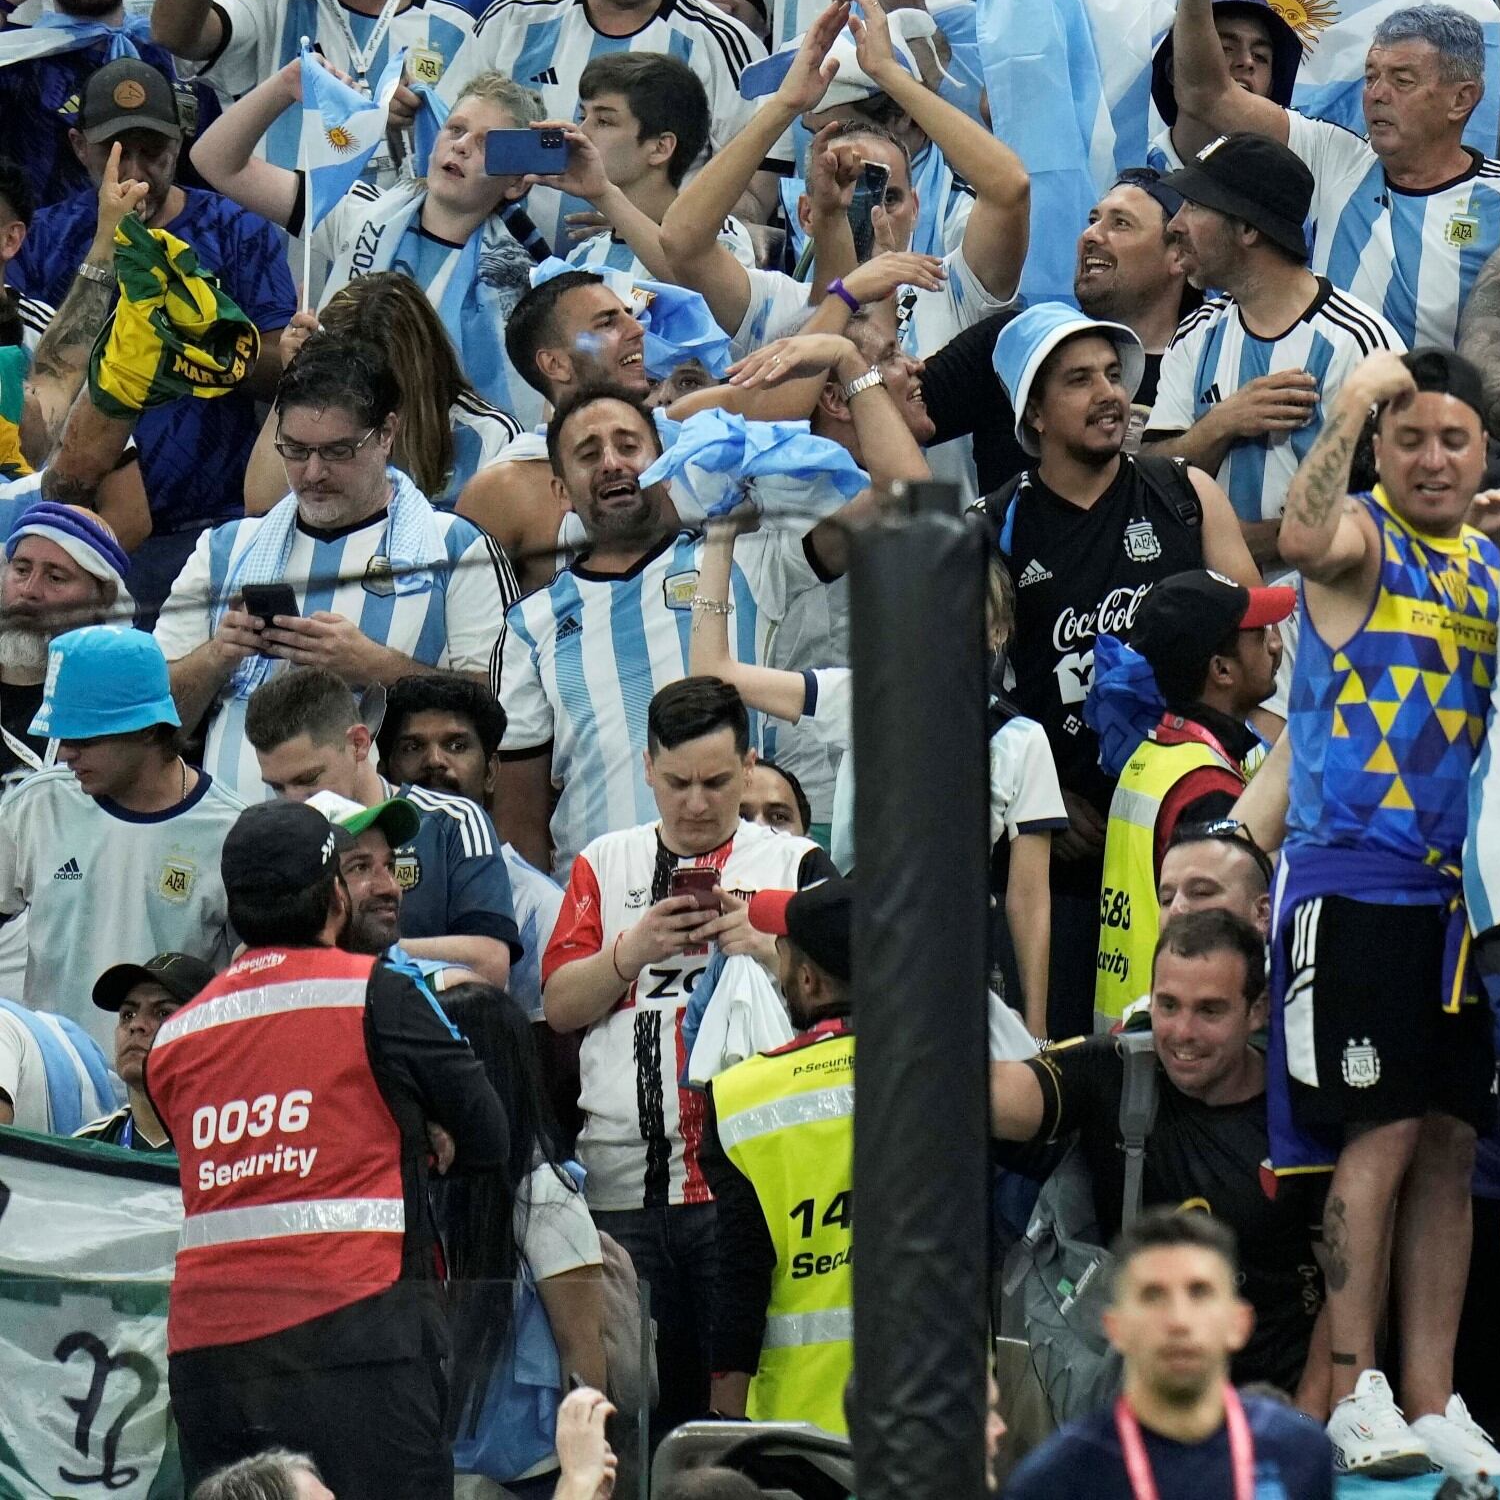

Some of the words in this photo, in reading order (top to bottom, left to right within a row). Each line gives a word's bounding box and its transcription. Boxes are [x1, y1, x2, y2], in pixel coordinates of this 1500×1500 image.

[172, 354, 217, 384] MAR
[1017, 571, 1054, 588] adidas
[555, 626, 584, 642] adidas
[53, 872, 84, 882] adidas
[192, 1089, 313, 1151] 0036
[197, 1146, 319, 1191] Security
